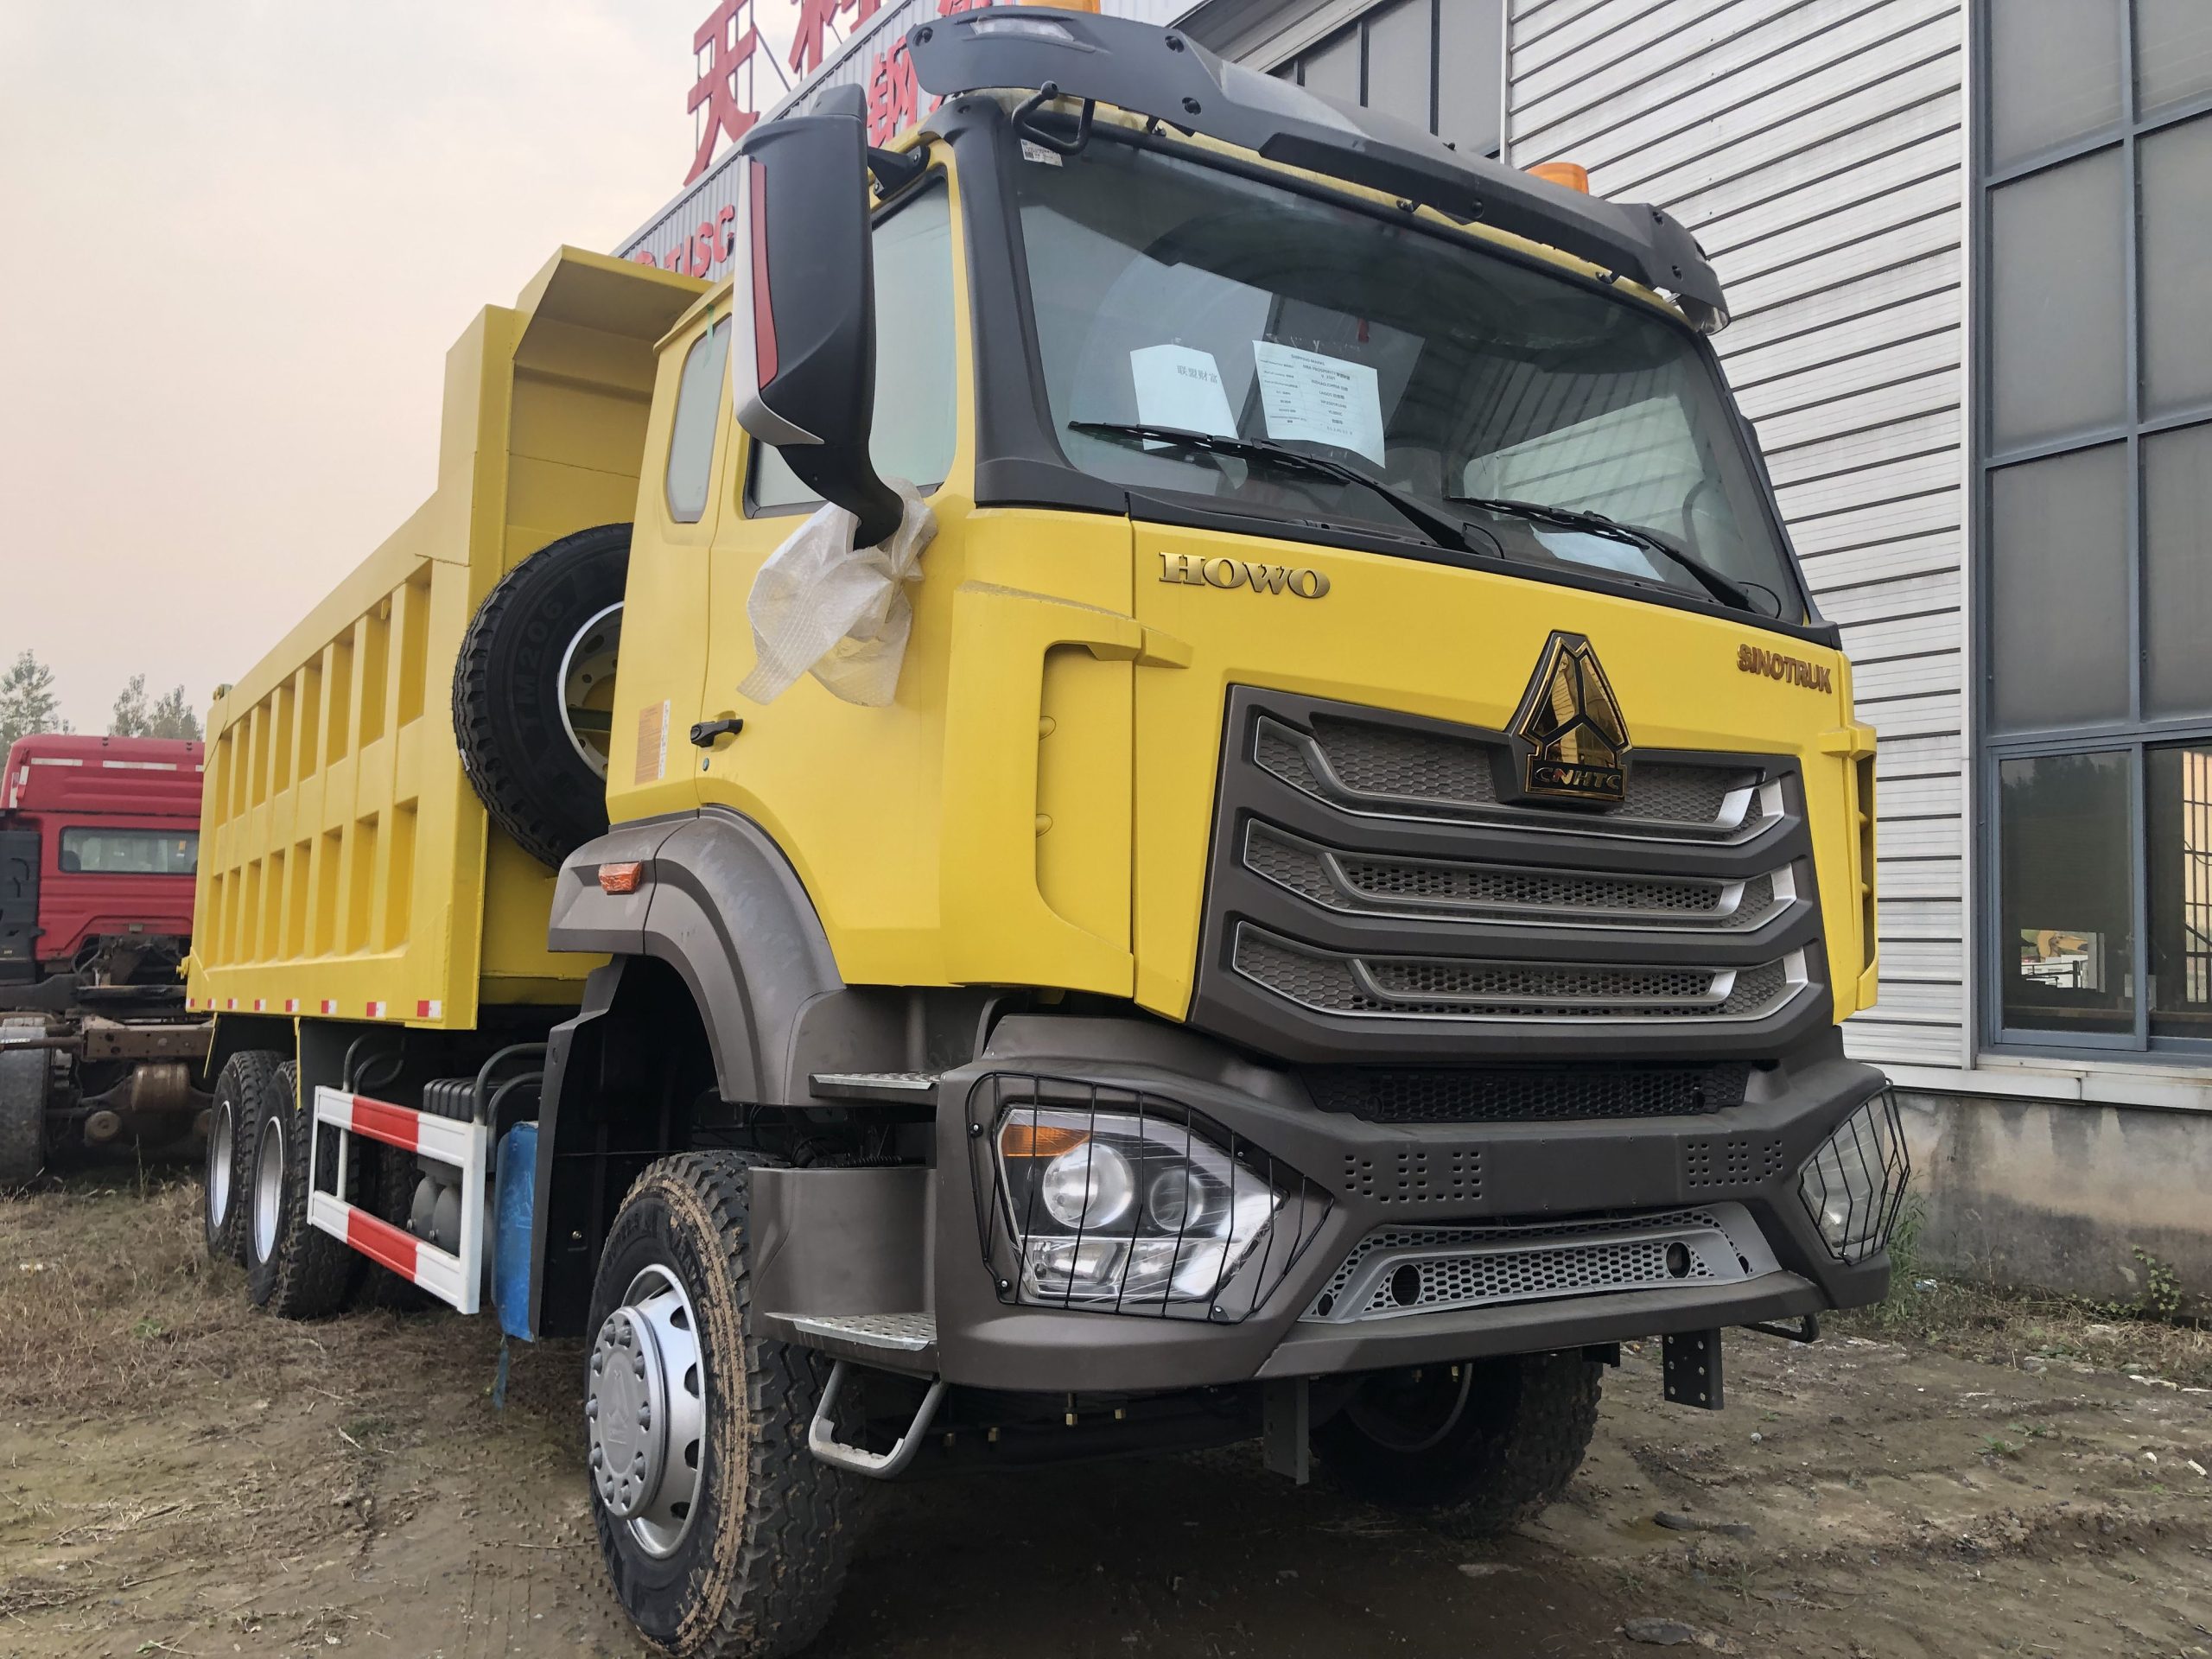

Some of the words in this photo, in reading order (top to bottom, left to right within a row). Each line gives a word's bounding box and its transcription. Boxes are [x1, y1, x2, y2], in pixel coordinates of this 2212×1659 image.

[1159, 551, 1332, 599] HOWO
[1737, 644, 1832, 694] SINOTRUK
[1534, 766, 1622, 790] CNHTC
